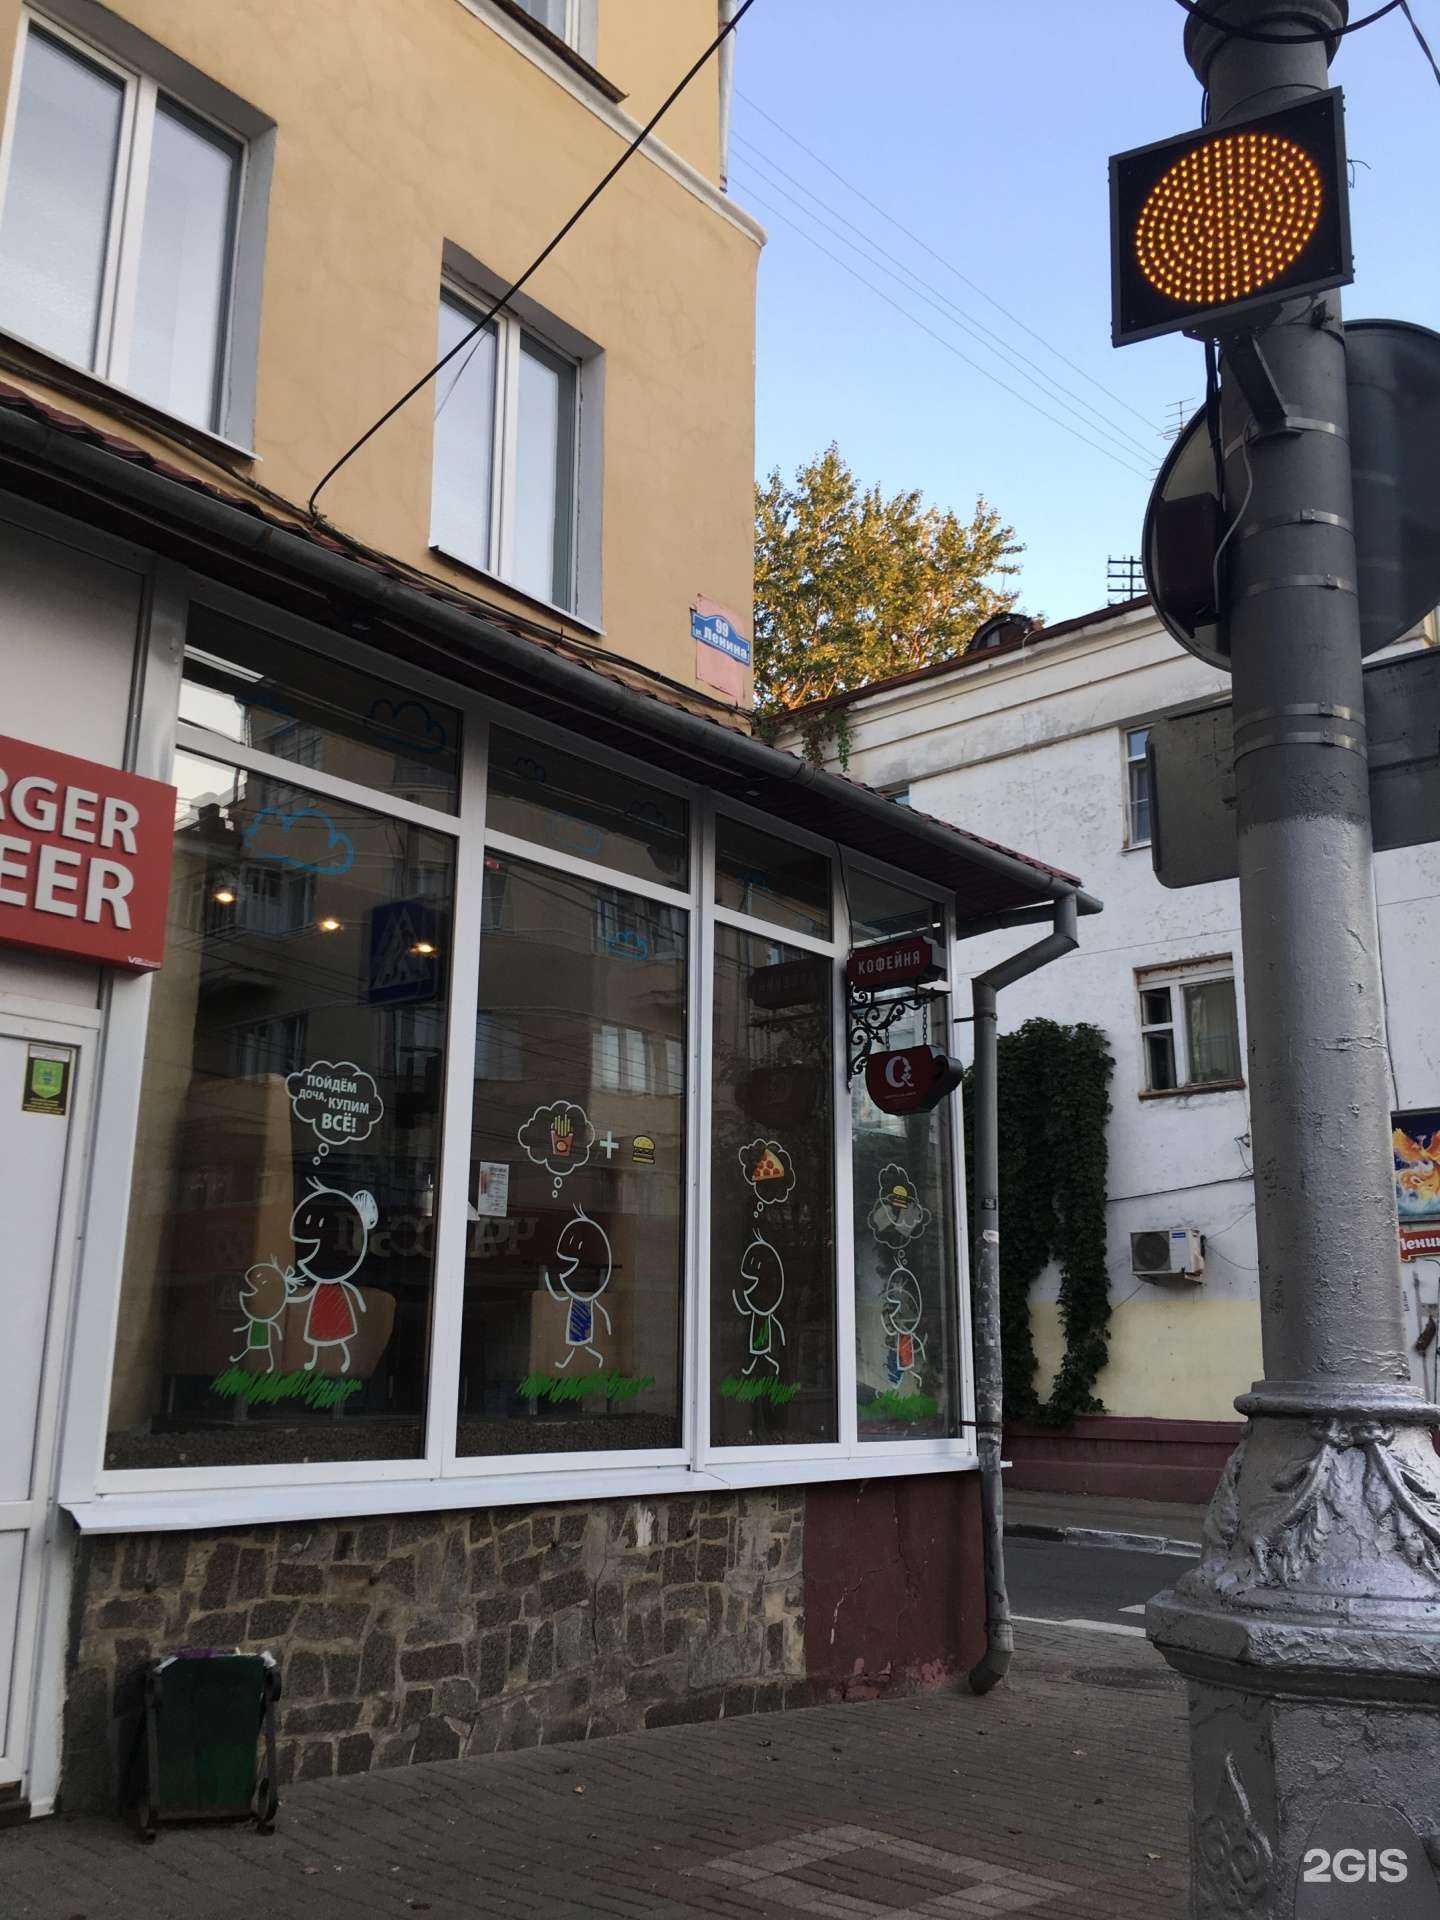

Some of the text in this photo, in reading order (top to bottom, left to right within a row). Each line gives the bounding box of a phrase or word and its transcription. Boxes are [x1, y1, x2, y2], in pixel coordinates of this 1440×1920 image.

[703, 626, 748, 659] Ленина
[0, 767, 140, 855] GER
[858, 950, 921, 976] КОФЕЙНЯ
[306, 1075, 358, 1094] ПОЙДЁМ
[328, 1097, 370, 1115] КУПИМ
[321, 1112, 357, 1133] ВСЁ!
